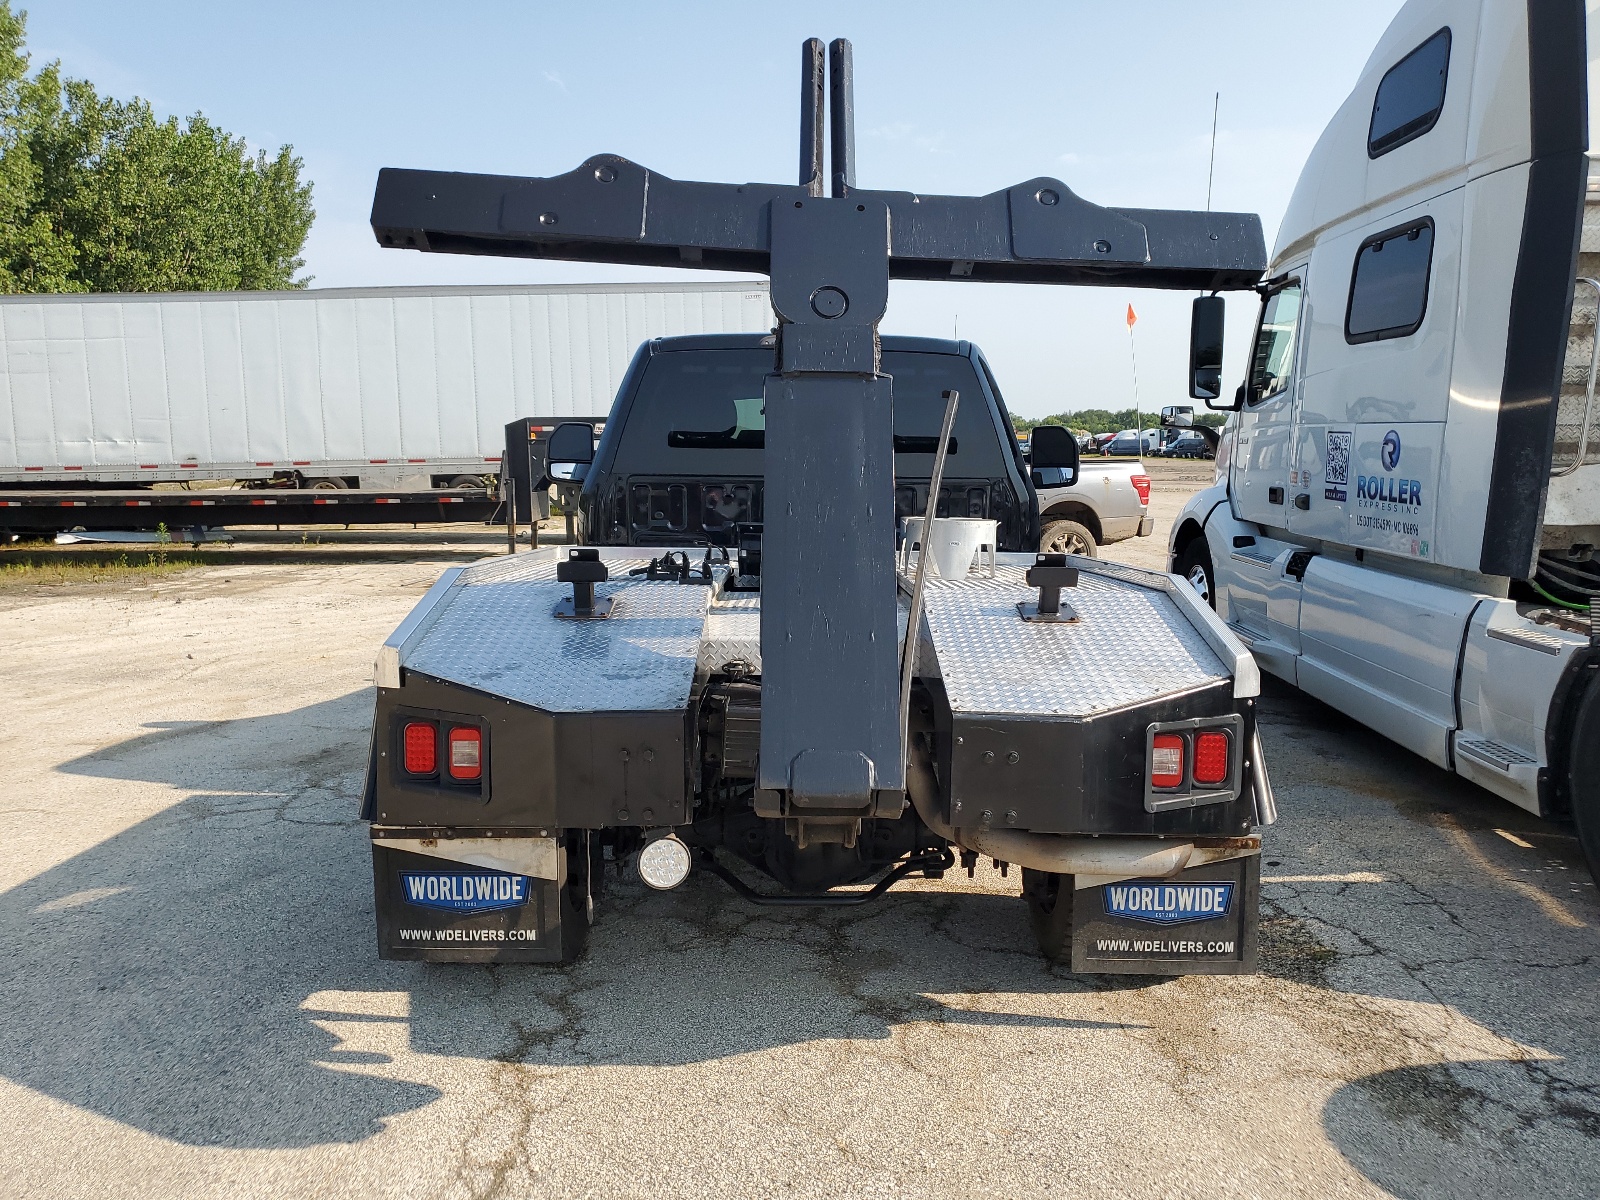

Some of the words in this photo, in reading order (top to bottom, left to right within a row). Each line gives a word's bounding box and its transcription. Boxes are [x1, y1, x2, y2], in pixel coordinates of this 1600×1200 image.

[1357, 475, 1422, 506] ROLLER
[1358, 500, 1398, 512] EXPRESS
[1401, 505, 1419, 515] INC
[408, 876, 523, 901] WORLDWIDE
[1110, 887, 1225, 912] WORLDWIDE
[399, 929, 537, 941] WWW.WDELIVERS.COM
[1096, 939, 1235, 953] WWW.WDELIVERS.COM
